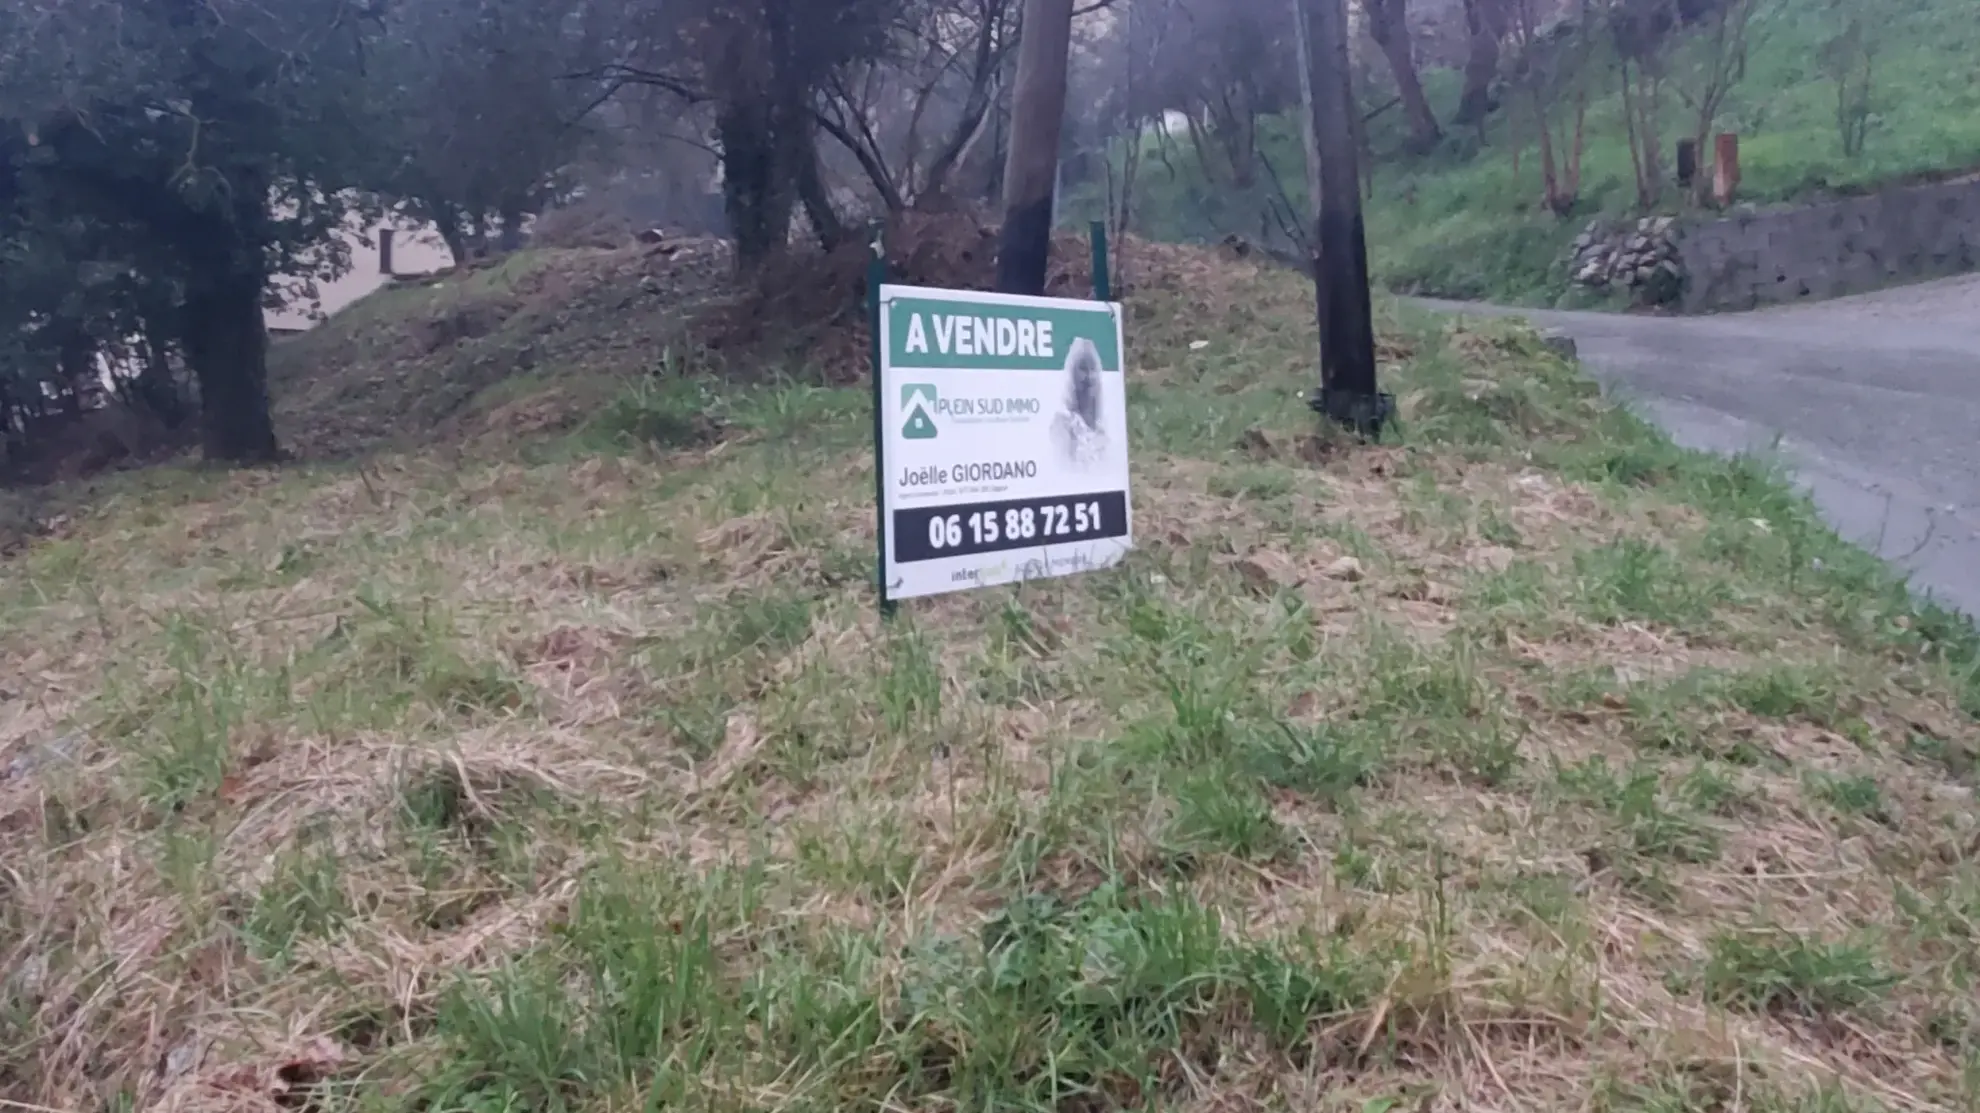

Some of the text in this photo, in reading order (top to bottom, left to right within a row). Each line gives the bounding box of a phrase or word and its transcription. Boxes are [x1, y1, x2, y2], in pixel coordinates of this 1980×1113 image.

[905, 313, 1054, 357] A VENDRE
[977, 398, 1003, 414] SUD
[1006, 398, 1040, 414] IMMO
[899, 460, 1037, 486] Joëlle GIORDANO
[929, 502, 1101, 549] 06 15 88 72 51
